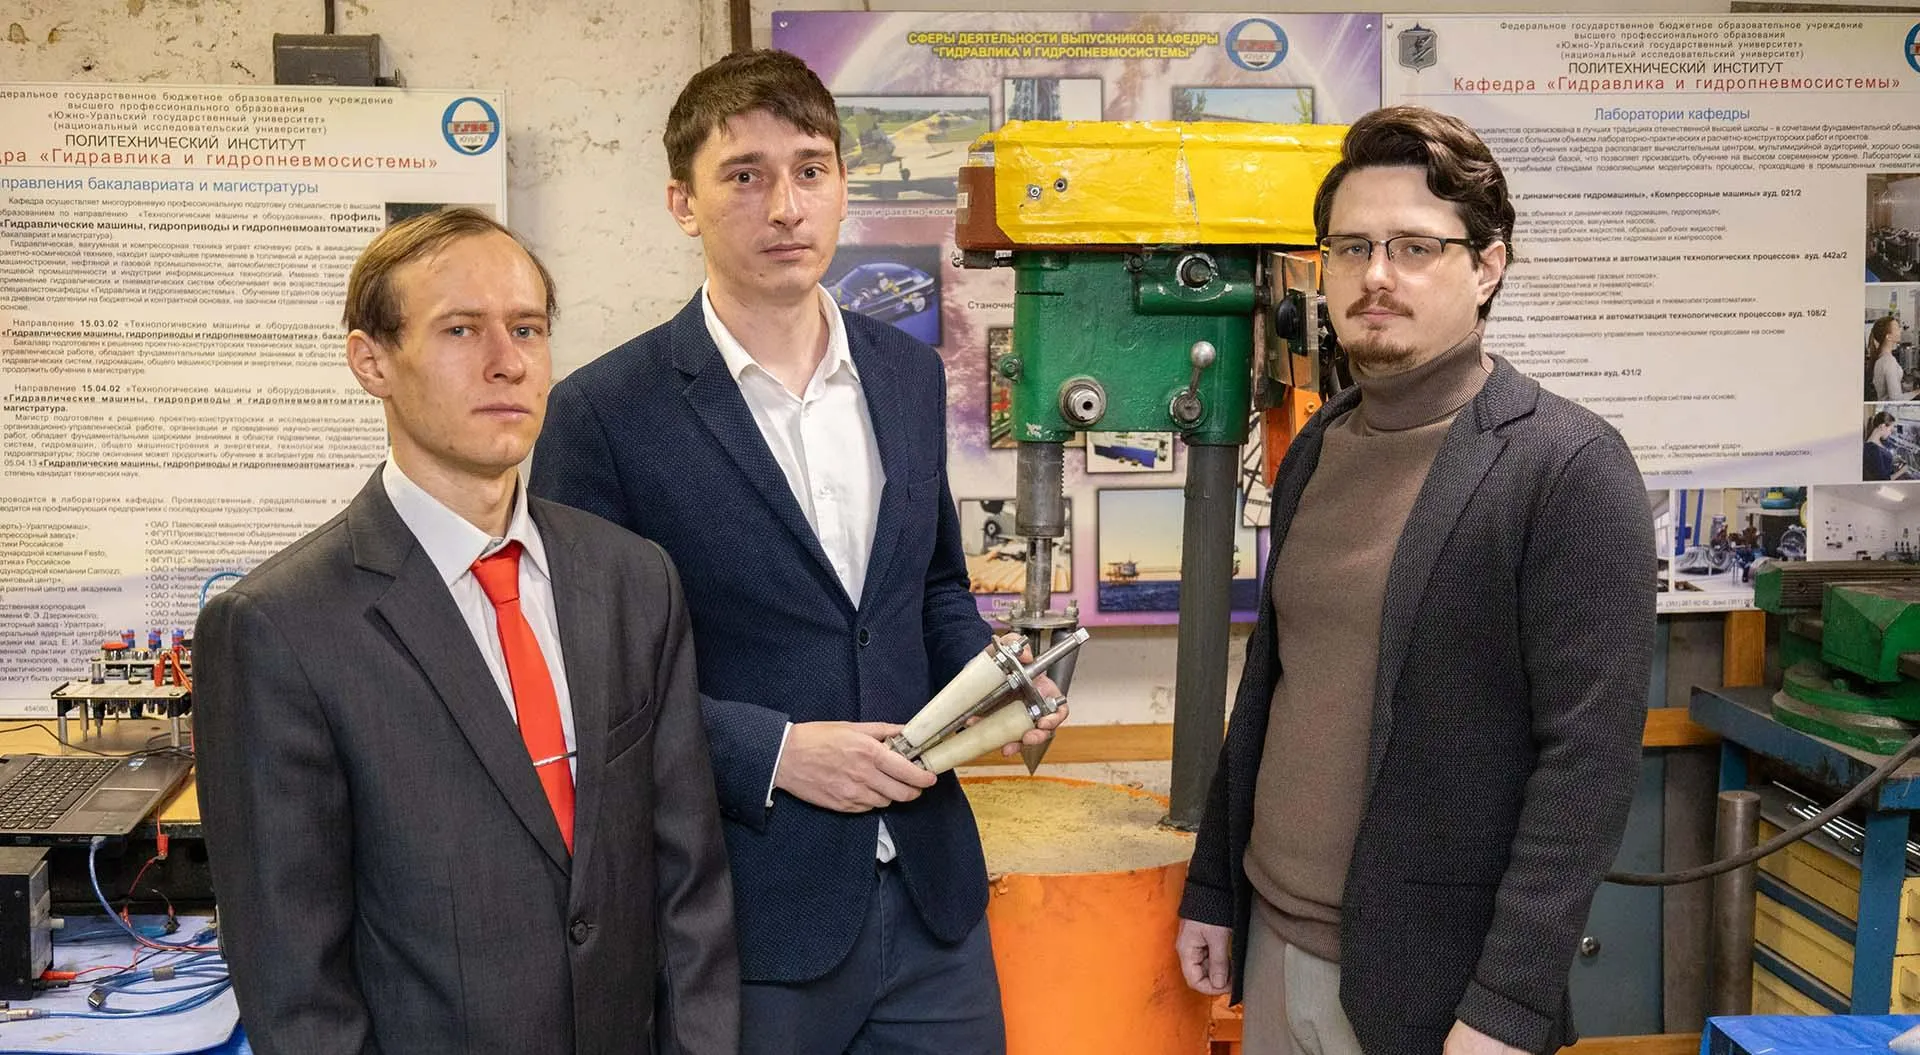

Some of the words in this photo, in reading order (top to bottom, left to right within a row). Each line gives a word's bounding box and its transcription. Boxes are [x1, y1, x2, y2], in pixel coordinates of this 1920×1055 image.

[909, 33, 955, 43] СФЕРЫ
[958, 32, 1058, 44] ДЕЯТЕЛЬНОСТИ
[1060, 33, 1154, 44] ВЫПУСКНИКОВ
[1157, 33, 1218, 44] КАФЕДРЫ
[1724, 31, 1785, 39] образования
[934, 47, 1019, 57] "ГИДРАВЛИКА
[1022, 46, 1031, 56] И
[1034, 46, 1195, 57] ГИДРОПНЕВМОСИСТЕМЫ"
[1568, 62, 1705, 73] ПОЛИТЕХНИЧЕСКИЙ
[1713, 62, 1782, 73] ИНСТИТУТ
[1454, 78, 1534, 92] Кафедра
[1548, 79, 1663, 93] «Гидравлика
[1676, 79, 1684, 89] и
[1696, 78, 1899, 94] гидропневмосистемы»
[0, 91, 58, 99] деральное
[64, 91, 156, 100] государственное
[162, 93, 222, 101] бюджетное
[228, 94, 322, 103] образовательное
[328, 96, 392, 105] учреждение
[66, 102, 114, 110] высшего
[120, 103, 229, 112] профессионального
[235, 105, 304, 113] образования
[48, 111, 148, 120] «Южно-Уральский
[152, 114, 246, 122] государственный
[252, 115, 324, 123] университет»
[1595, 107, 1684, 120] Лаборатории
[1688, 109, 1749, 122] кафедры
[54, 122, 137, 130] (национальный
[144, 124, 248, 132] исследовательский
[256, 125, 326, 134] университет)
[65, 134, 218, 149] ПОЛИТЕХНИЧЕСКИЙ
[228, 137, 305, 150] ИНСТИТУТ
[40, 151, 170, 169] «Гидравлика
[184, 153, 193, 164] и
[206, 154, 437, 169] гидропневмосистемы»
[0, 178, 82, 191] правления
[88, 179, 193, 193] бакалавриата
[199, 181, 207, 191] и
[213, 181, 318, 195] магистратуры
[884, 207, 953, 217] ракетно-косм
[0, 220, 94, 229] «Гидравлические
[148, 222, 229, 232] гидроприводы
[241, 224, 383, 233] гидропневмоавтоматика»
[967, 300, 1016, 310] Станочно
[1486, 314, 1524, 323] опривод,
[322, 332, 348, 340] бакал
[3, 395, 95, 403] «Гидравлические
[153, 396, 230, 404] гидроприводы
[248, 397, 383, 405] гидропневмоавтоматика»
